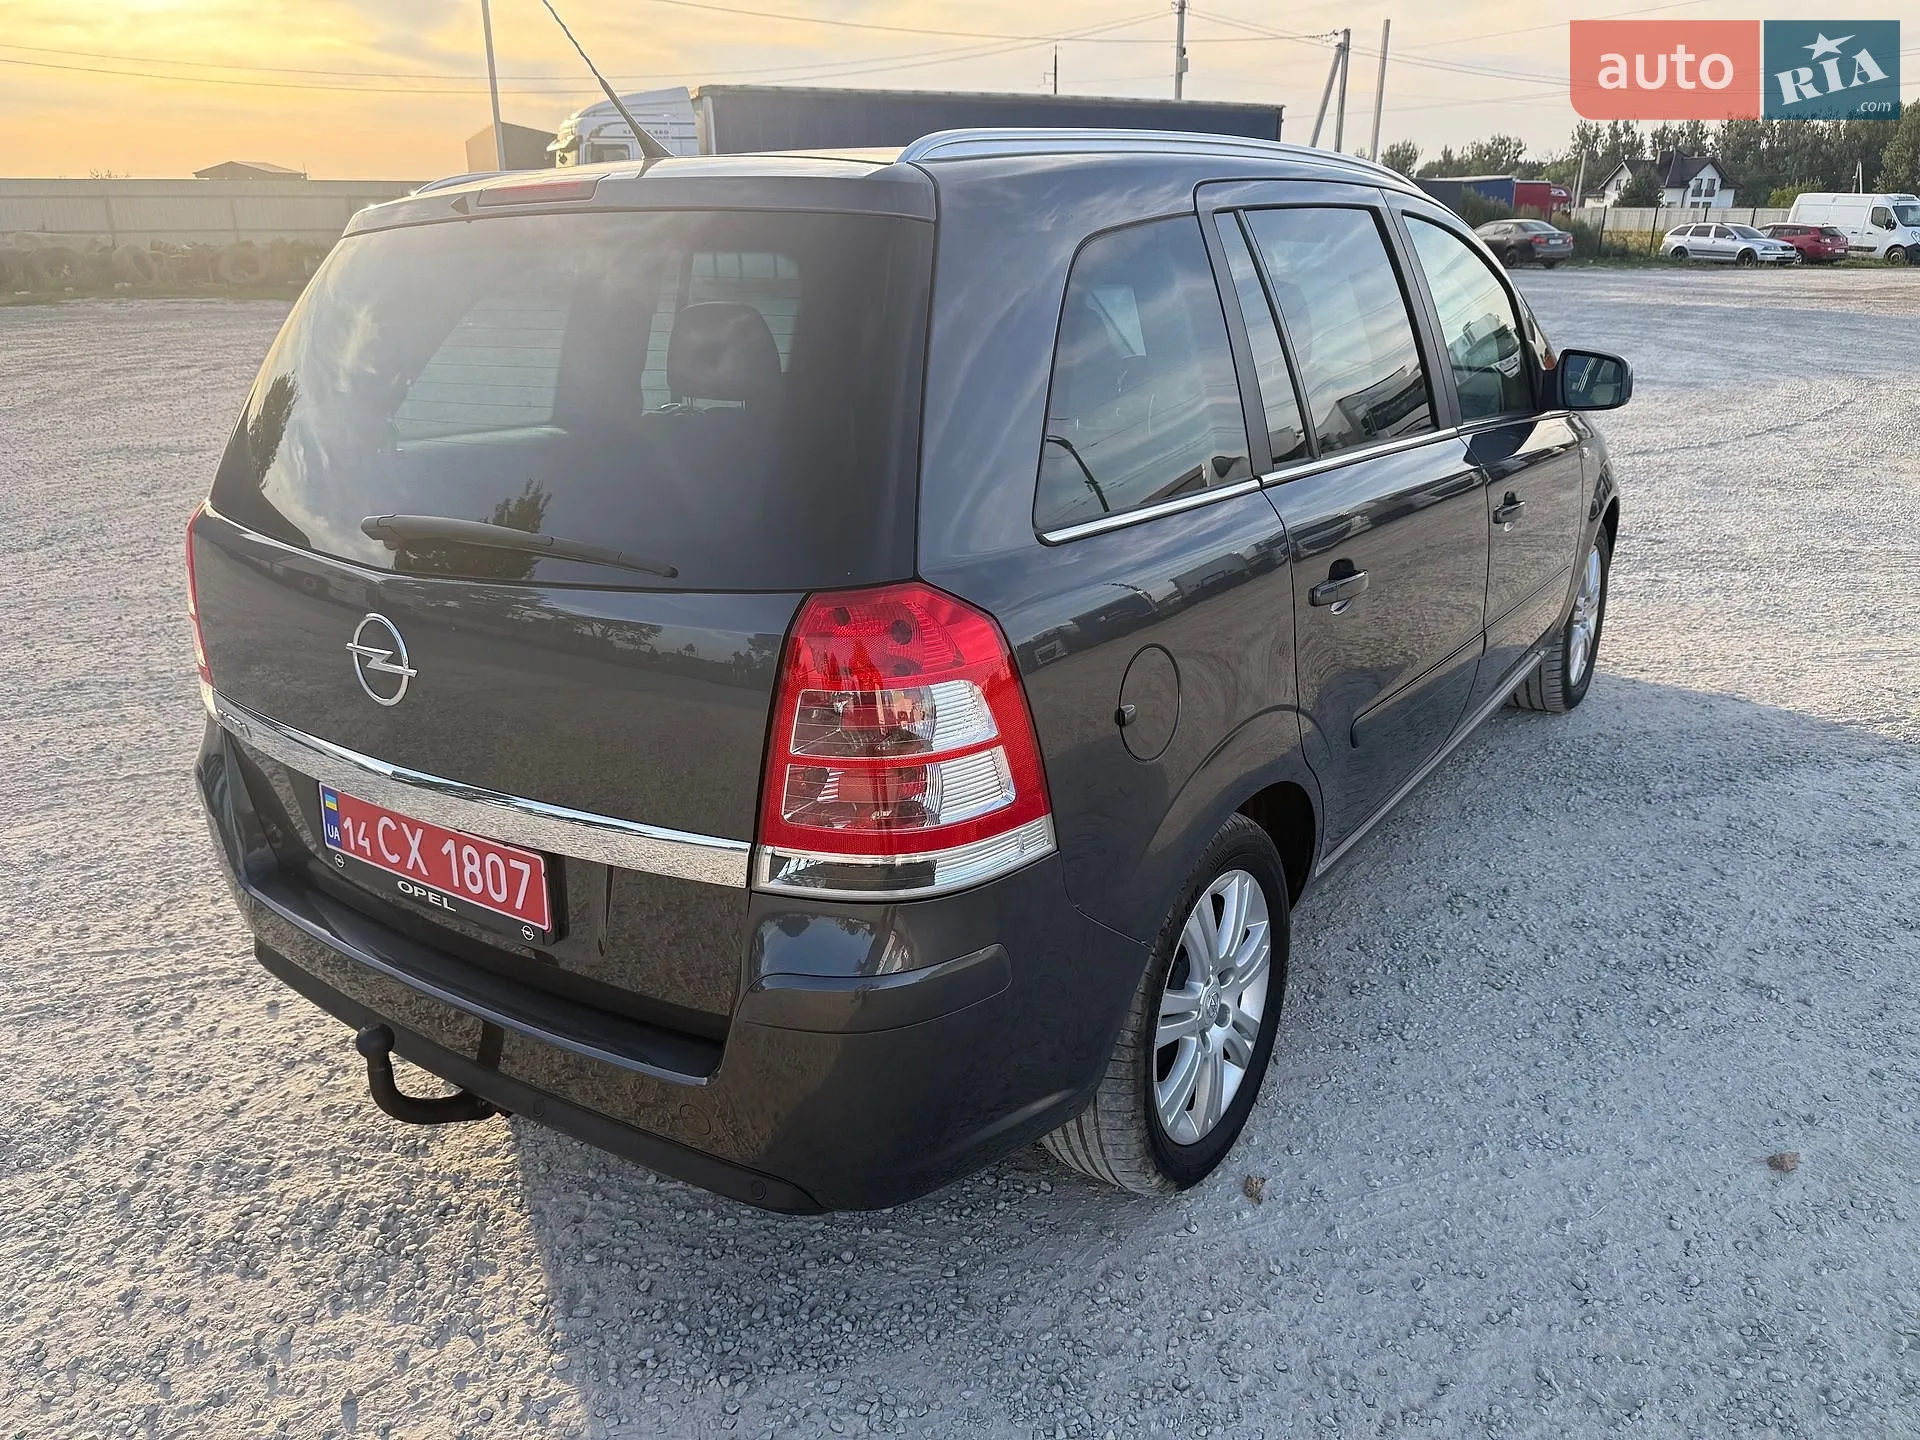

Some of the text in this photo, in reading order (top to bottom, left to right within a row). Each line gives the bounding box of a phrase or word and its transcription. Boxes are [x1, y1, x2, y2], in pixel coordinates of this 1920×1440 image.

[327, 823, 341, 841] UA
[343, 816, 531, 910] 14 CX 1807
[397, 880, 457, 912] OPEL
